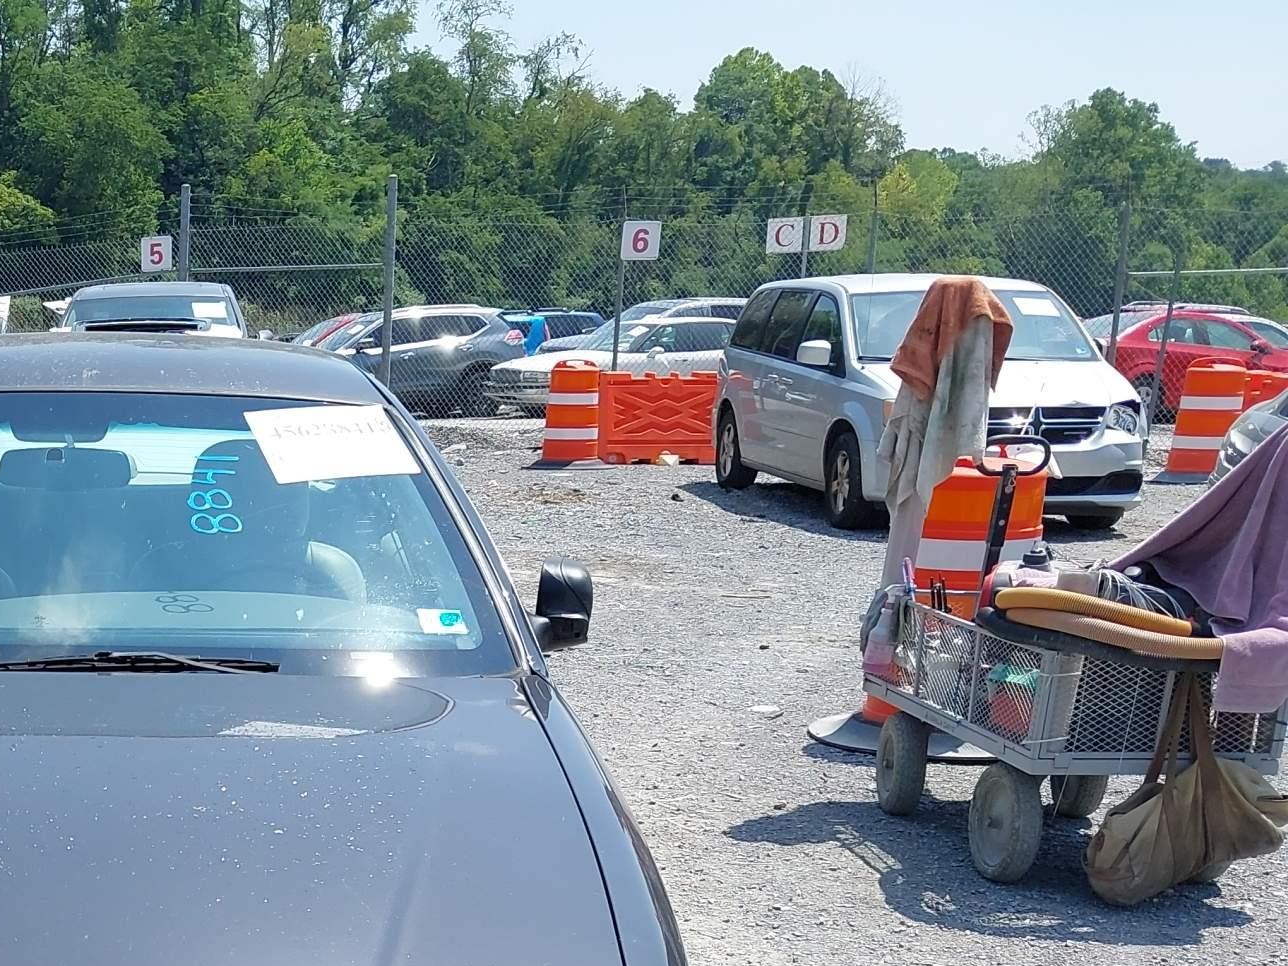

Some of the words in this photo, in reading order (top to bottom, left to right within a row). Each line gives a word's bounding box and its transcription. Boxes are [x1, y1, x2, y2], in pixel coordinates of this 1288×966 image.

[631, 228, 650, 254] 6
[775, 223, 795, 248] C
[817, 221, 840, 245] D
[150, 243, 163, 265] 5
